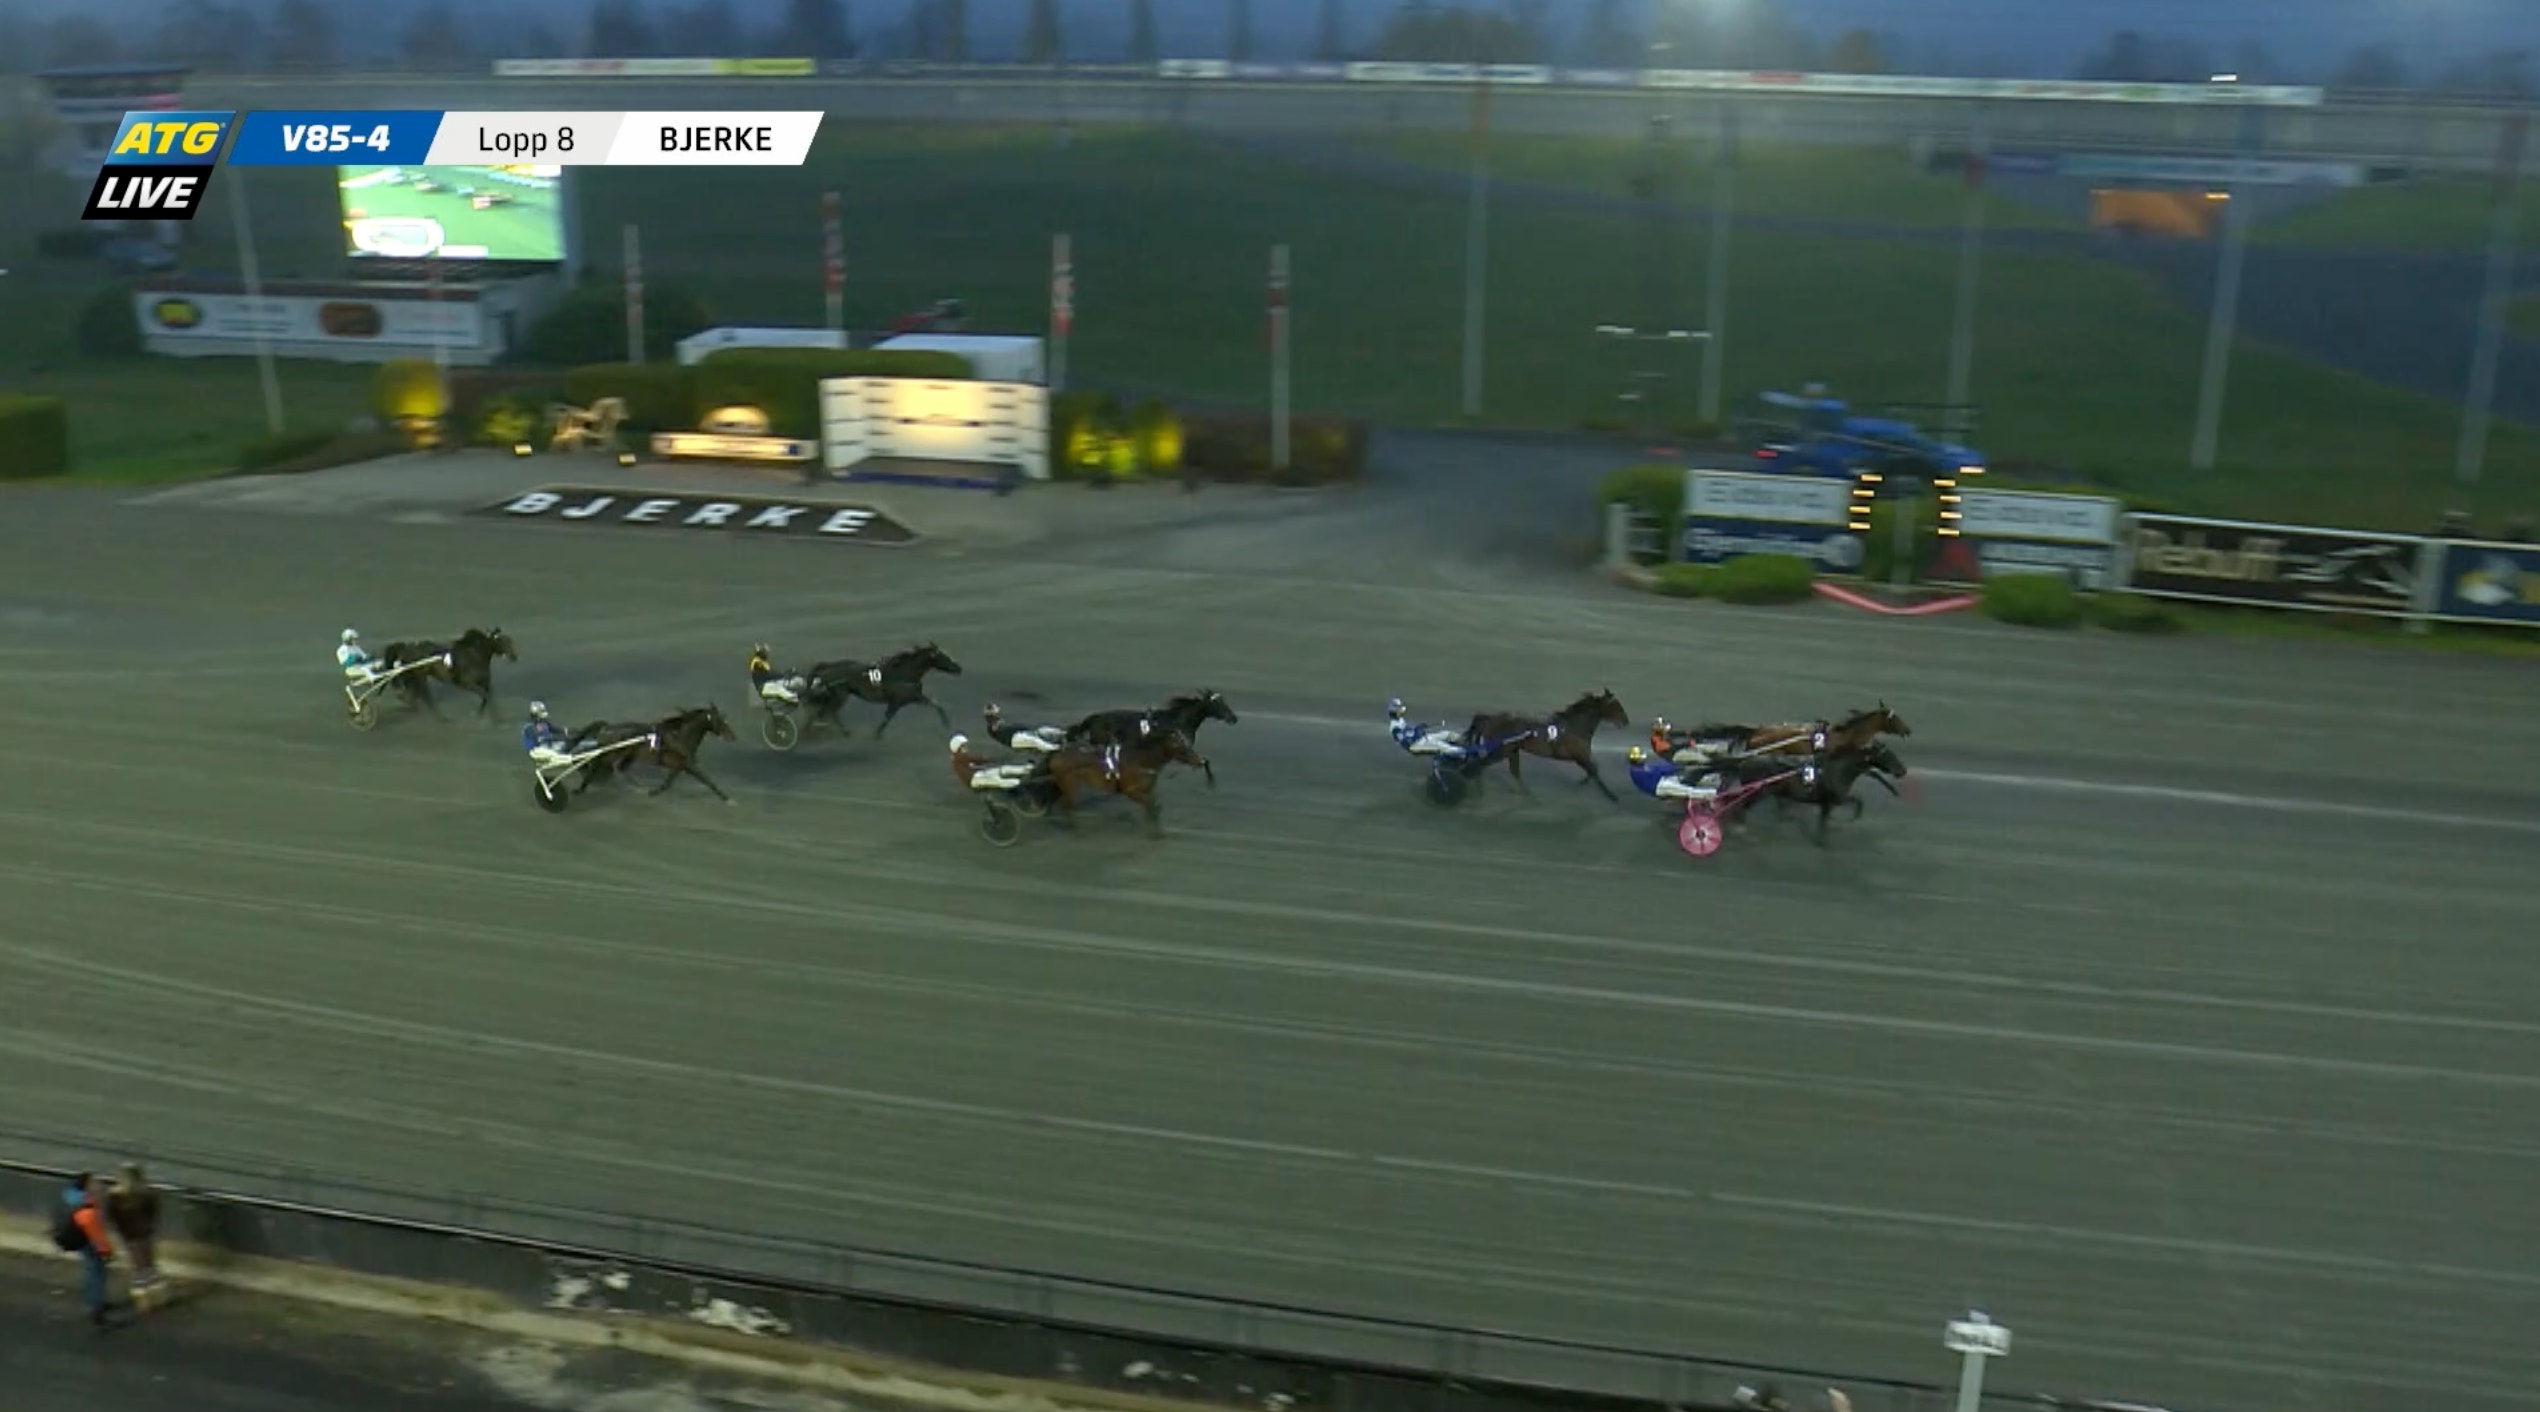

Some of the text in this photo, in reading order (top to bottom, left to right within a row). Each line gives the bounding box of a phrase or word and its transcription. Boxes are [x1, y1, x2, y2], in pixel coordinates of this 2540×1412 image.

[504, 491, 877, 534] BJERKE
[868, 668, 882, 684] 10
[646, 732, 657, 749] 7
[1814, 732, 1825, 749] 2
[1804, 766, 1815, 782] 3
